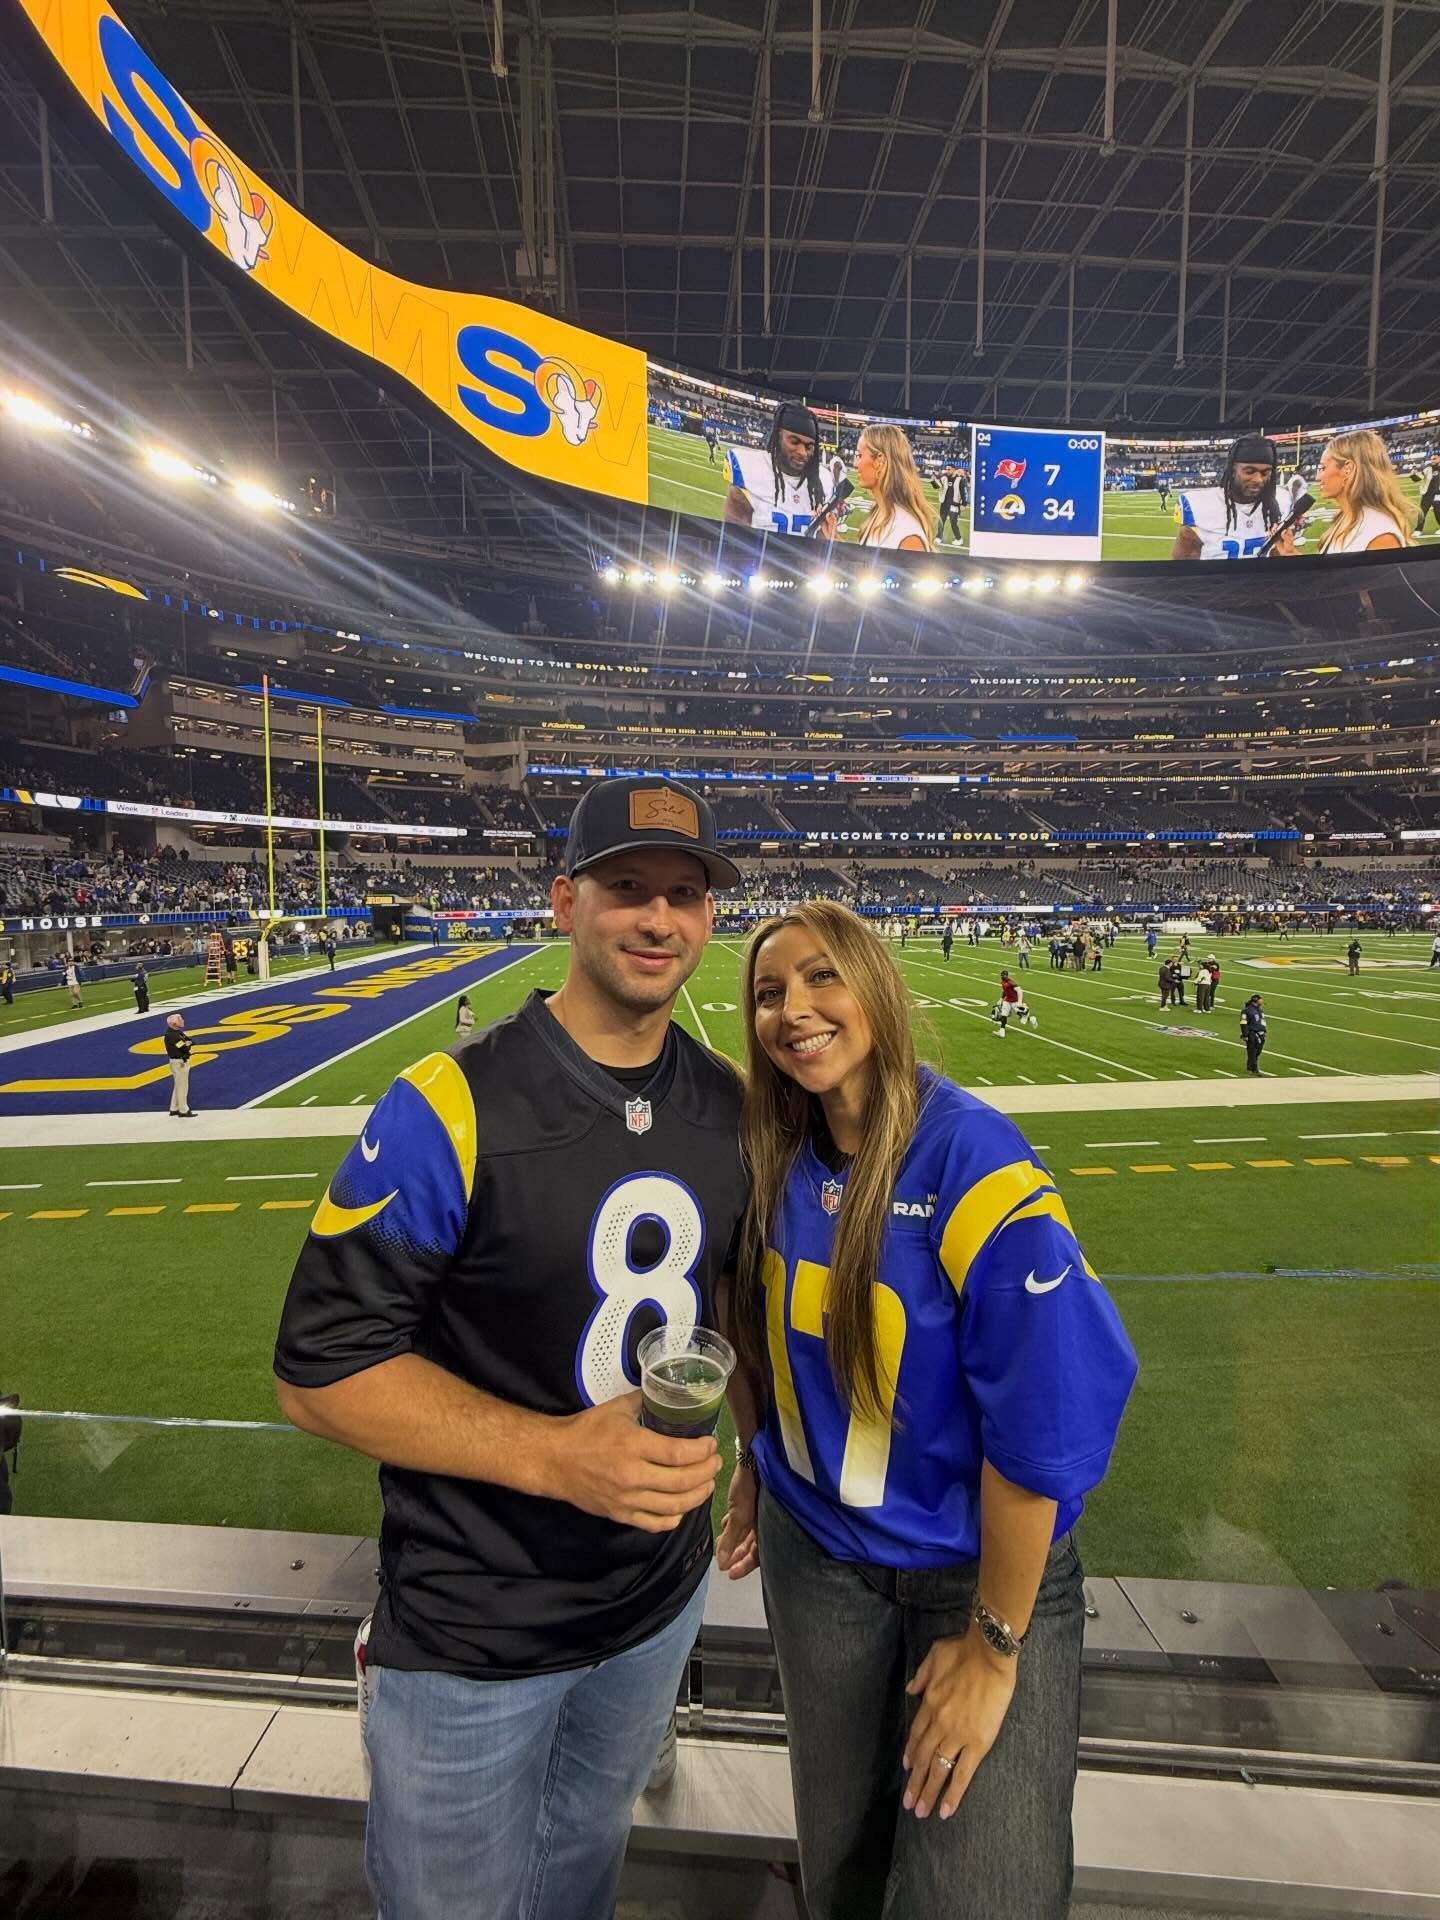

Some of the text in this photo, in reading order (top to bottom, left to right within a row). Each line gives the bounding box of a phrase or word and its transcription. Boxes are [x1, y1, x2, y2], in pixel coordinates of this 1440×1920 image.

[1068, 439, 1099, 450] 0:00
[1044, 464, 1061, 486] 7
[1043, 498, 1075, 520] 34
[464, 651, 524, 665] WELCOME
[549, 661, 571, 669] THE
[576, 663, 613, 672] ROYAL
[617, 665, 649, 674] TOUR
[807, 832, 1050, 840] WELCOME TO THE ROYAL TOUR
[1246, 904, 1295, 912] HOUSE
[22, 917, 102, 930] HOUSE
[233, 941, 248, 956] 25
[631, 1113, 649, 1128] NFL
[824, 1193, 839, 1210] NFL
[578, 1171, 706, 1407] 8
[762, 1248, 906, 1507] 17
